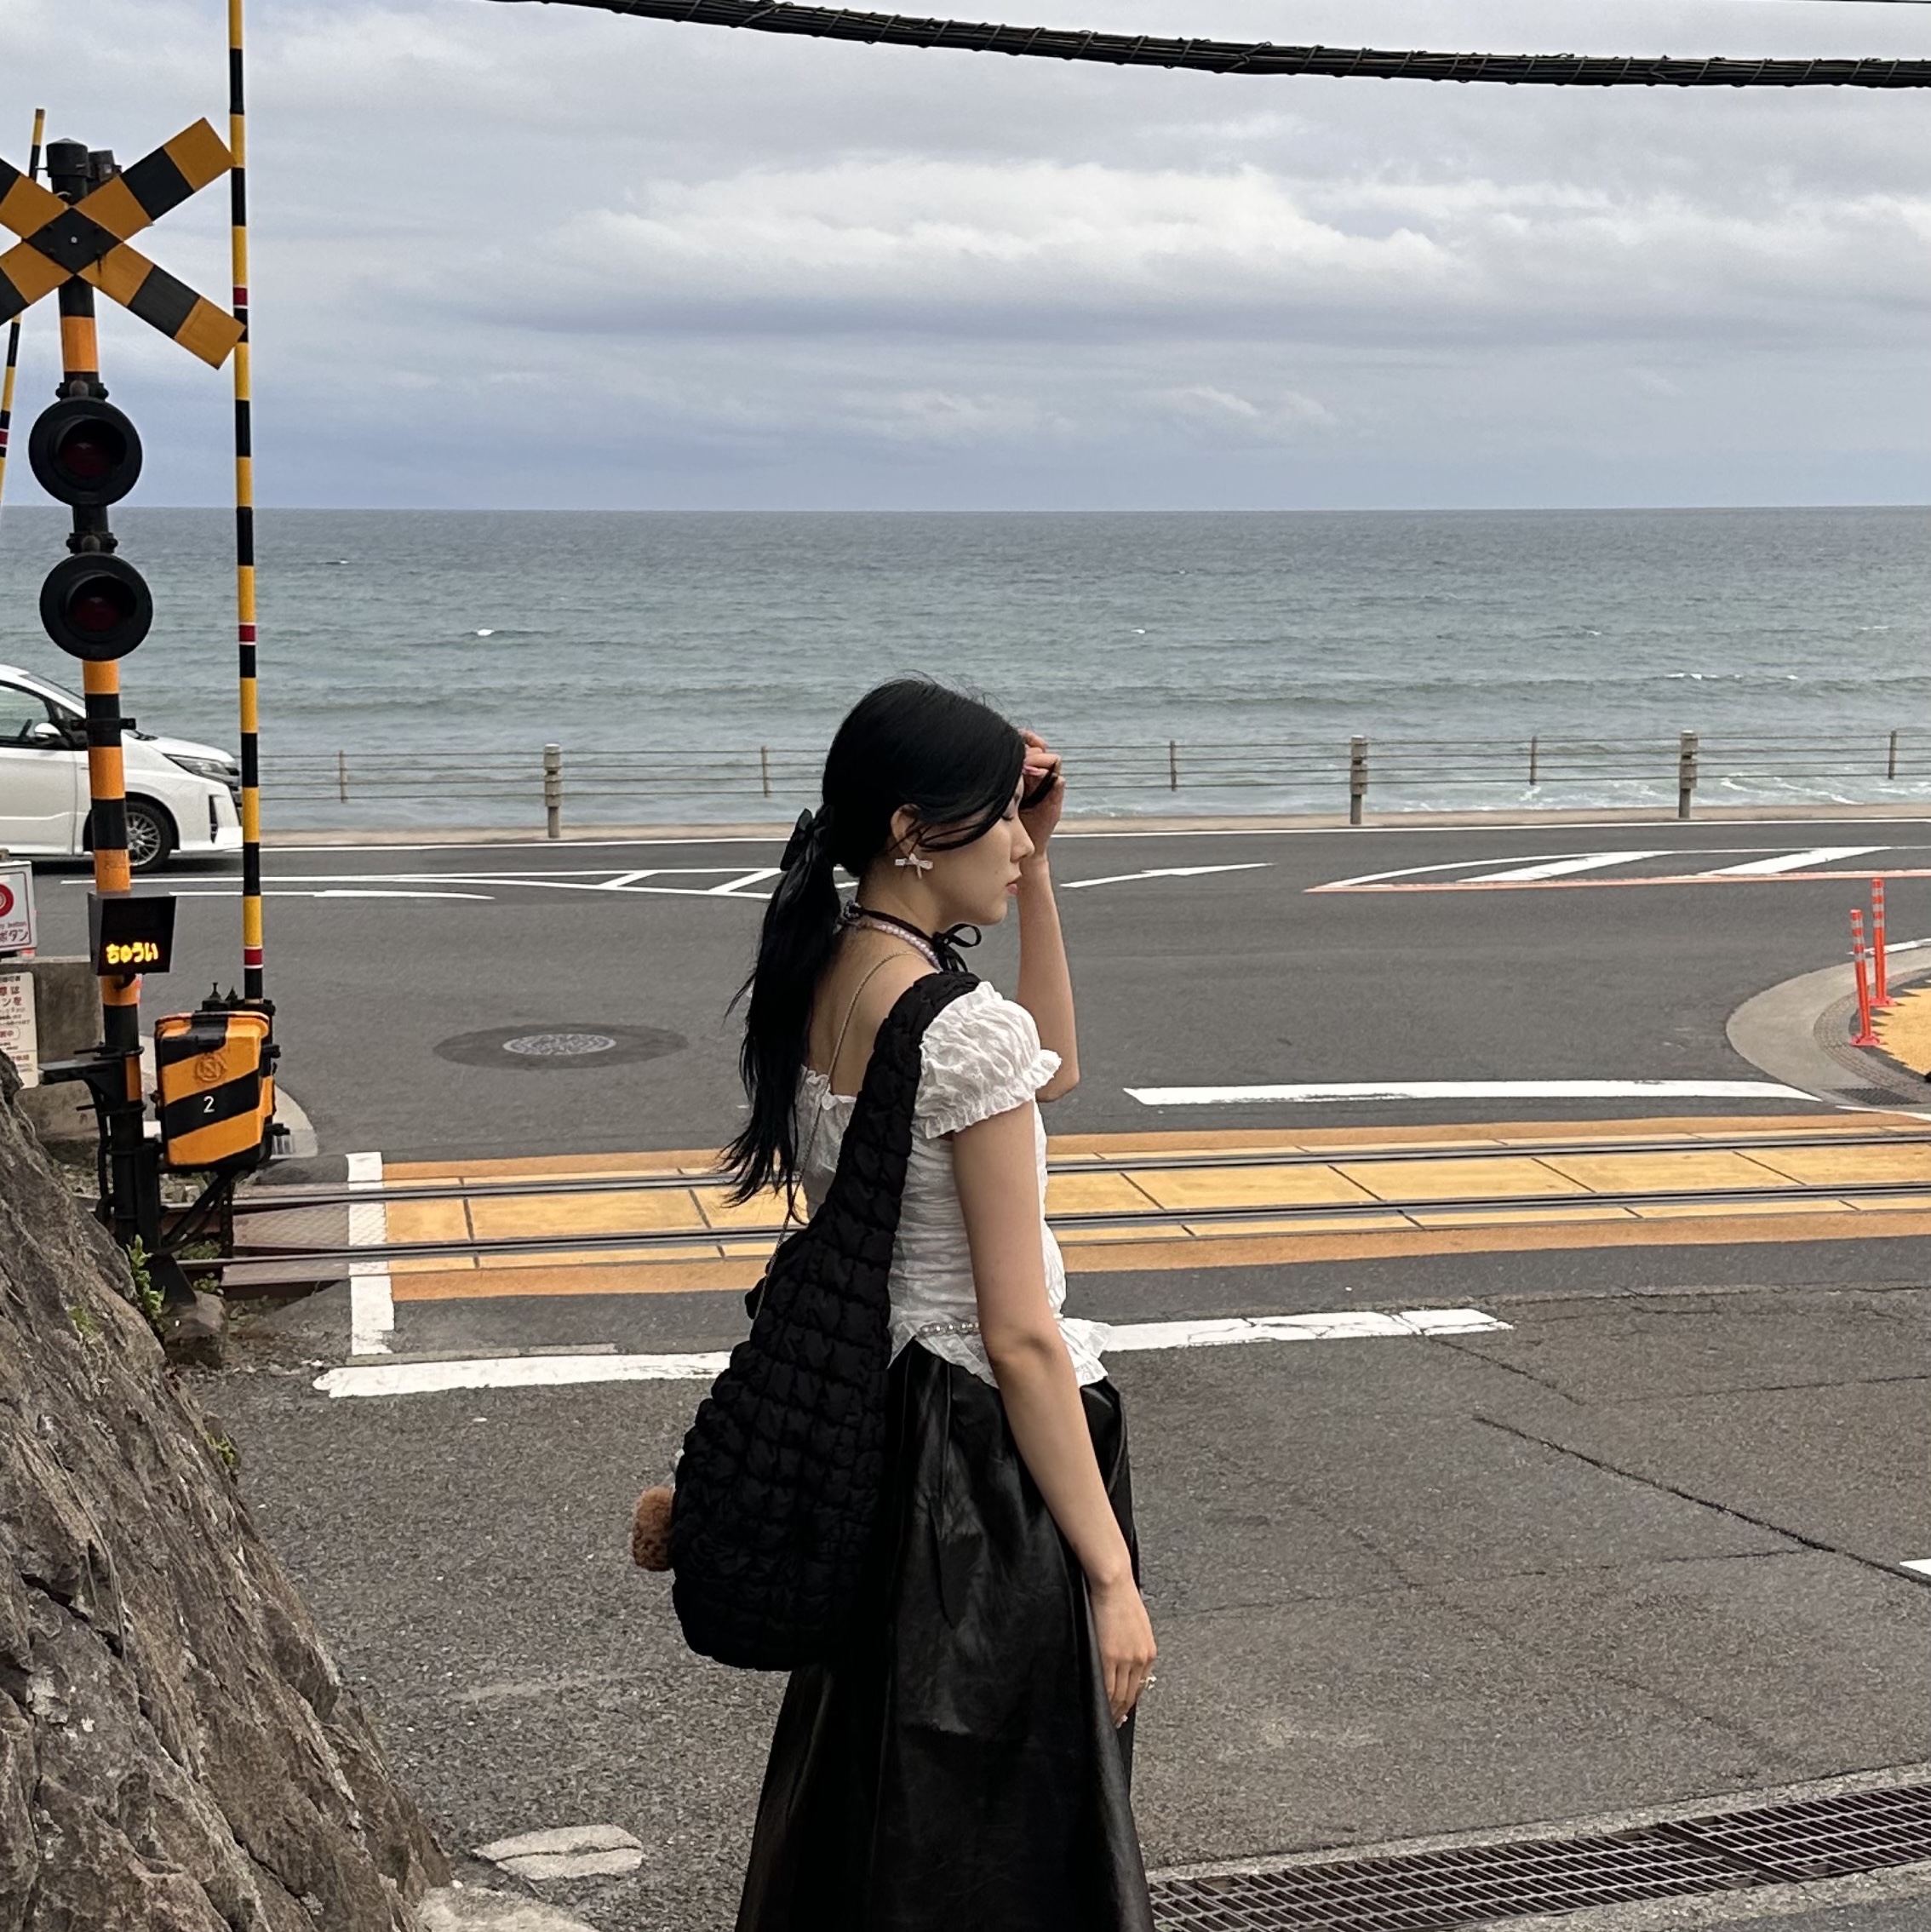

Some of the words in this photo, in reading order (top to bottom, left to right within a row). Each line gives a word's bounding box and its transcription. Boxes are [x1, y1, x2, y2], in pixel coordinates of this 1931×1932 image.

[106, 942, 158, 965] ちゅうい
[203, 1095, 215, 1114] 2
